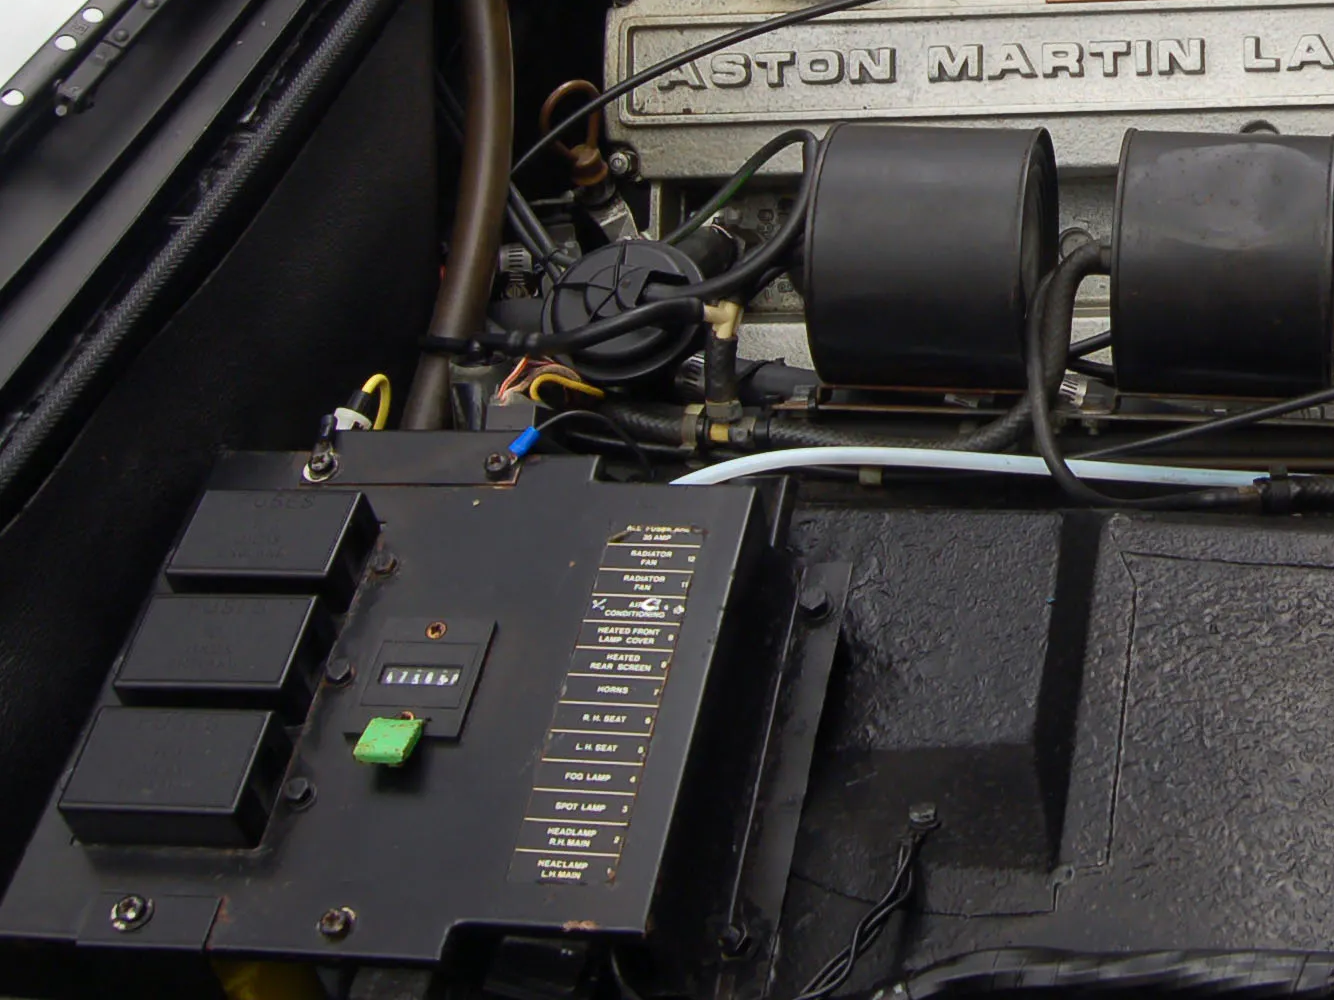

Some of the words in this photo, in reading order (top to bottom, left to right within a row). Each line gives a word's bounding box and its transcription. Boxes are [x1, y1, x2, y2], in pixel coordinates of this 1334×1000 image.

[658, 47, 898, 92] ASTON
[927, 37, 1206, 84] MARTIN
[630, 549, 673, 558] RADIATOR
[623, 574, 666, 583] RADIATOR
[604, 609, 666, 618] CONDITIONING
[597, 626, 631, 635] HEATED
[631, 627, 661, 636] FRONT
[598, 635, 623, 643] LAMP
[625, 637, 655, 645] COVER
[606, 653, 641, 662] HEATED
[589, 662, 614, 670] REAR
[617, 663, 652, 672] SCREEN
[596, 685, 629, 694] HORNS
[603, 714, 627, 723] SEAT
[595, 743, 618, 752] SEAT
[564, 772, 584, 781] FOG
[586, 773, 612, 782] LAMP
[554, 801, 579, 811] SPOT
[580, 803, 607, 812] LAMP
[546, 827, 598, 837] HEADLAMP
[566, 838, 591, 848] MAIN
[537, 859, 589, 870] HEADLAMP
[557, 870, 582, 880] MAIN
